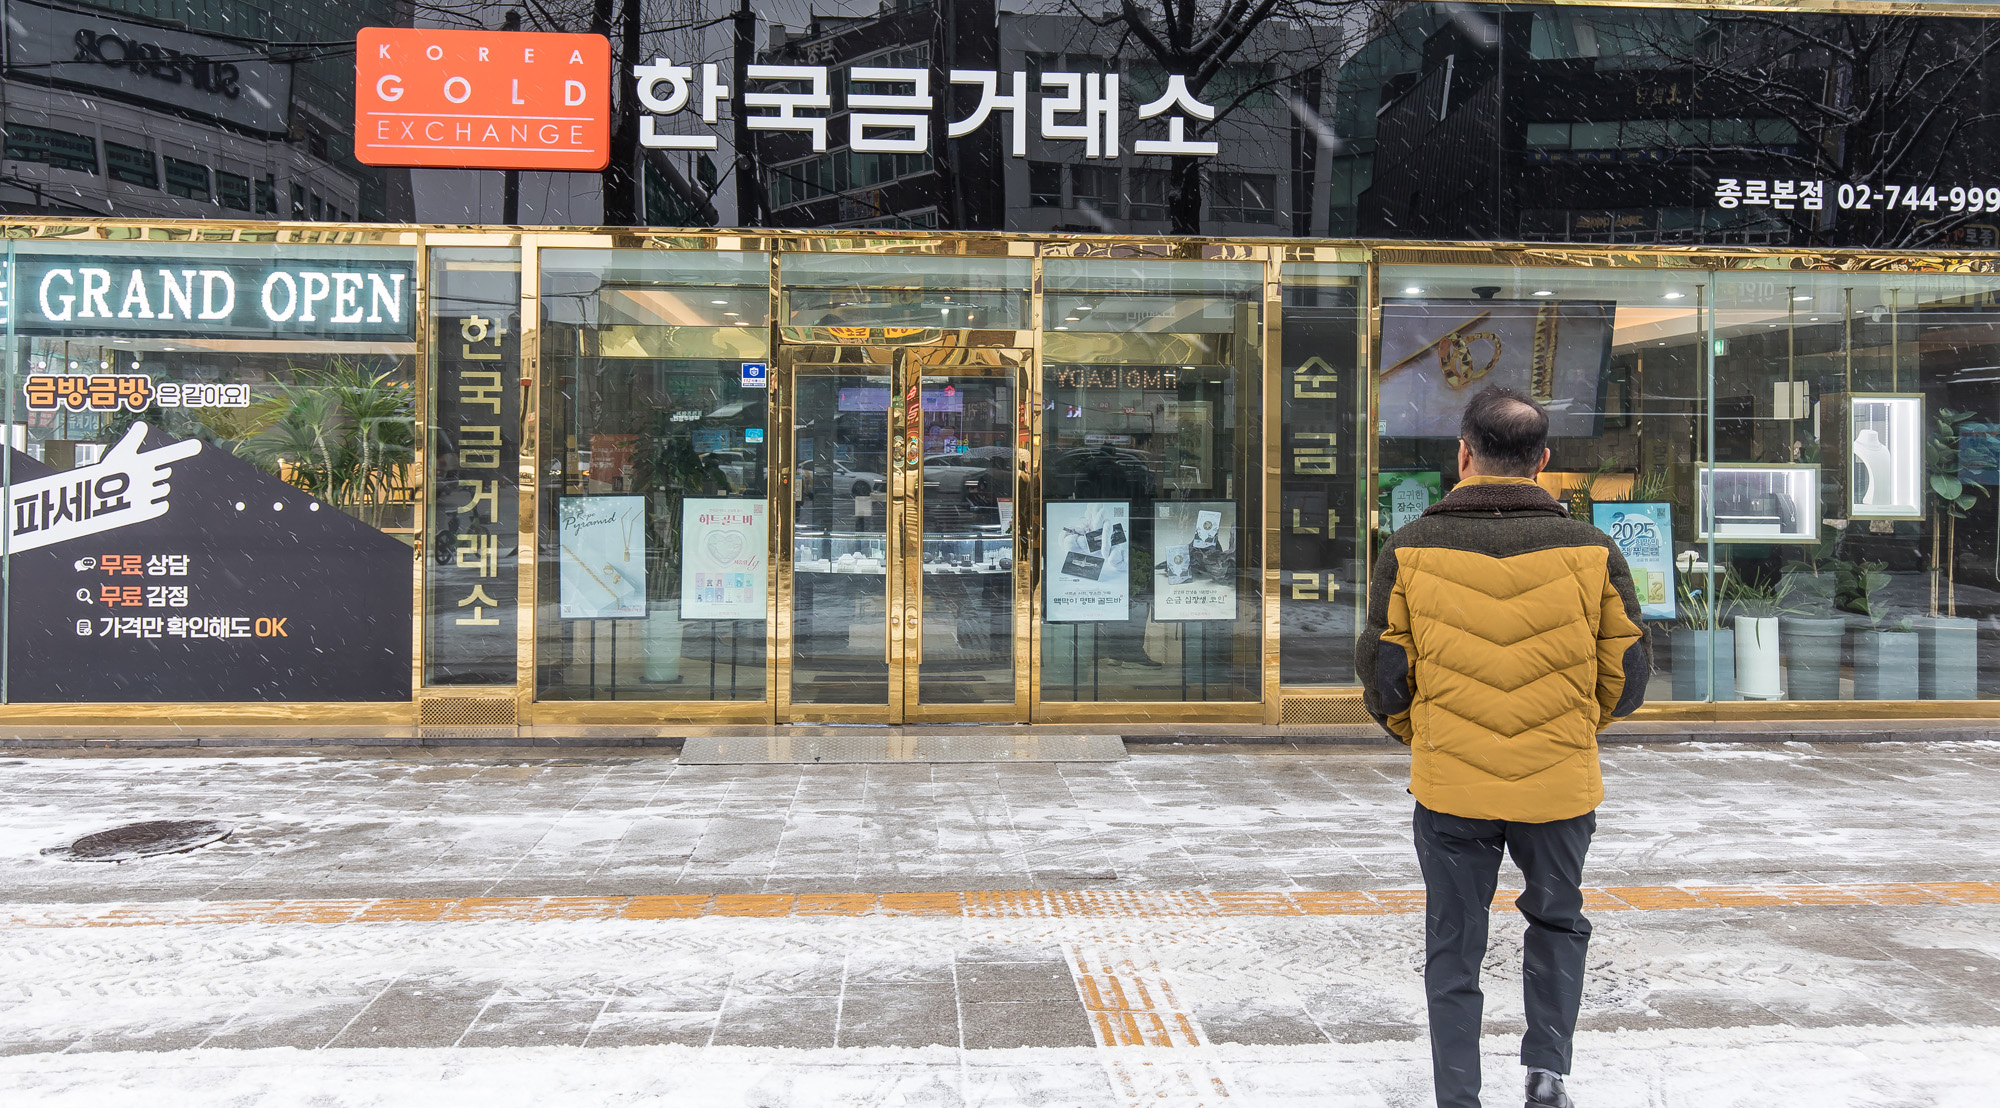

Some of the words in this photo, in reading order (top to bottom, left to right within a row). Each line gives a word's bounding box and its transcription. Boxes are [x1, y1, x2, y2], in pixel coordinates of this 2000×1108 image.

[379, 44, 585, 66] KOREA
[376, 75, 587, 107] GOLD
[633, 57, 1219, 158] 한국금거래소
[377, 120, 585, 145] EXCHANGE
[1715, 178, 1824, 211] 종로본점
[39, 267, 236, 322] GRAND
[261, 271, 405, 324] OPEN
[184, 384, 250, 406] 같아요!
[455, 314, 507, 627] 한국금거래소
[1291, 356, 1340, 603] 순금나라
[12, 472, 132, 537] 파세요
[1396, 489, 1424, 501] 고귀한
[562, 511, 617, 536] Pyramid
[1612, 522, 1657, 546] 2025
[100, 554, 144, 577] 무료
[146, 553, 191, 577] 상담
[100, 584, 144, 608] 무료
[146, 584, 190, 608] 감정
[1165, 596, 1182, 605] 순금
[99, 616, 164, 639] 가격만
[166, 616, 252, 639] 확인해도
[255, 618, 288, 638] OK
